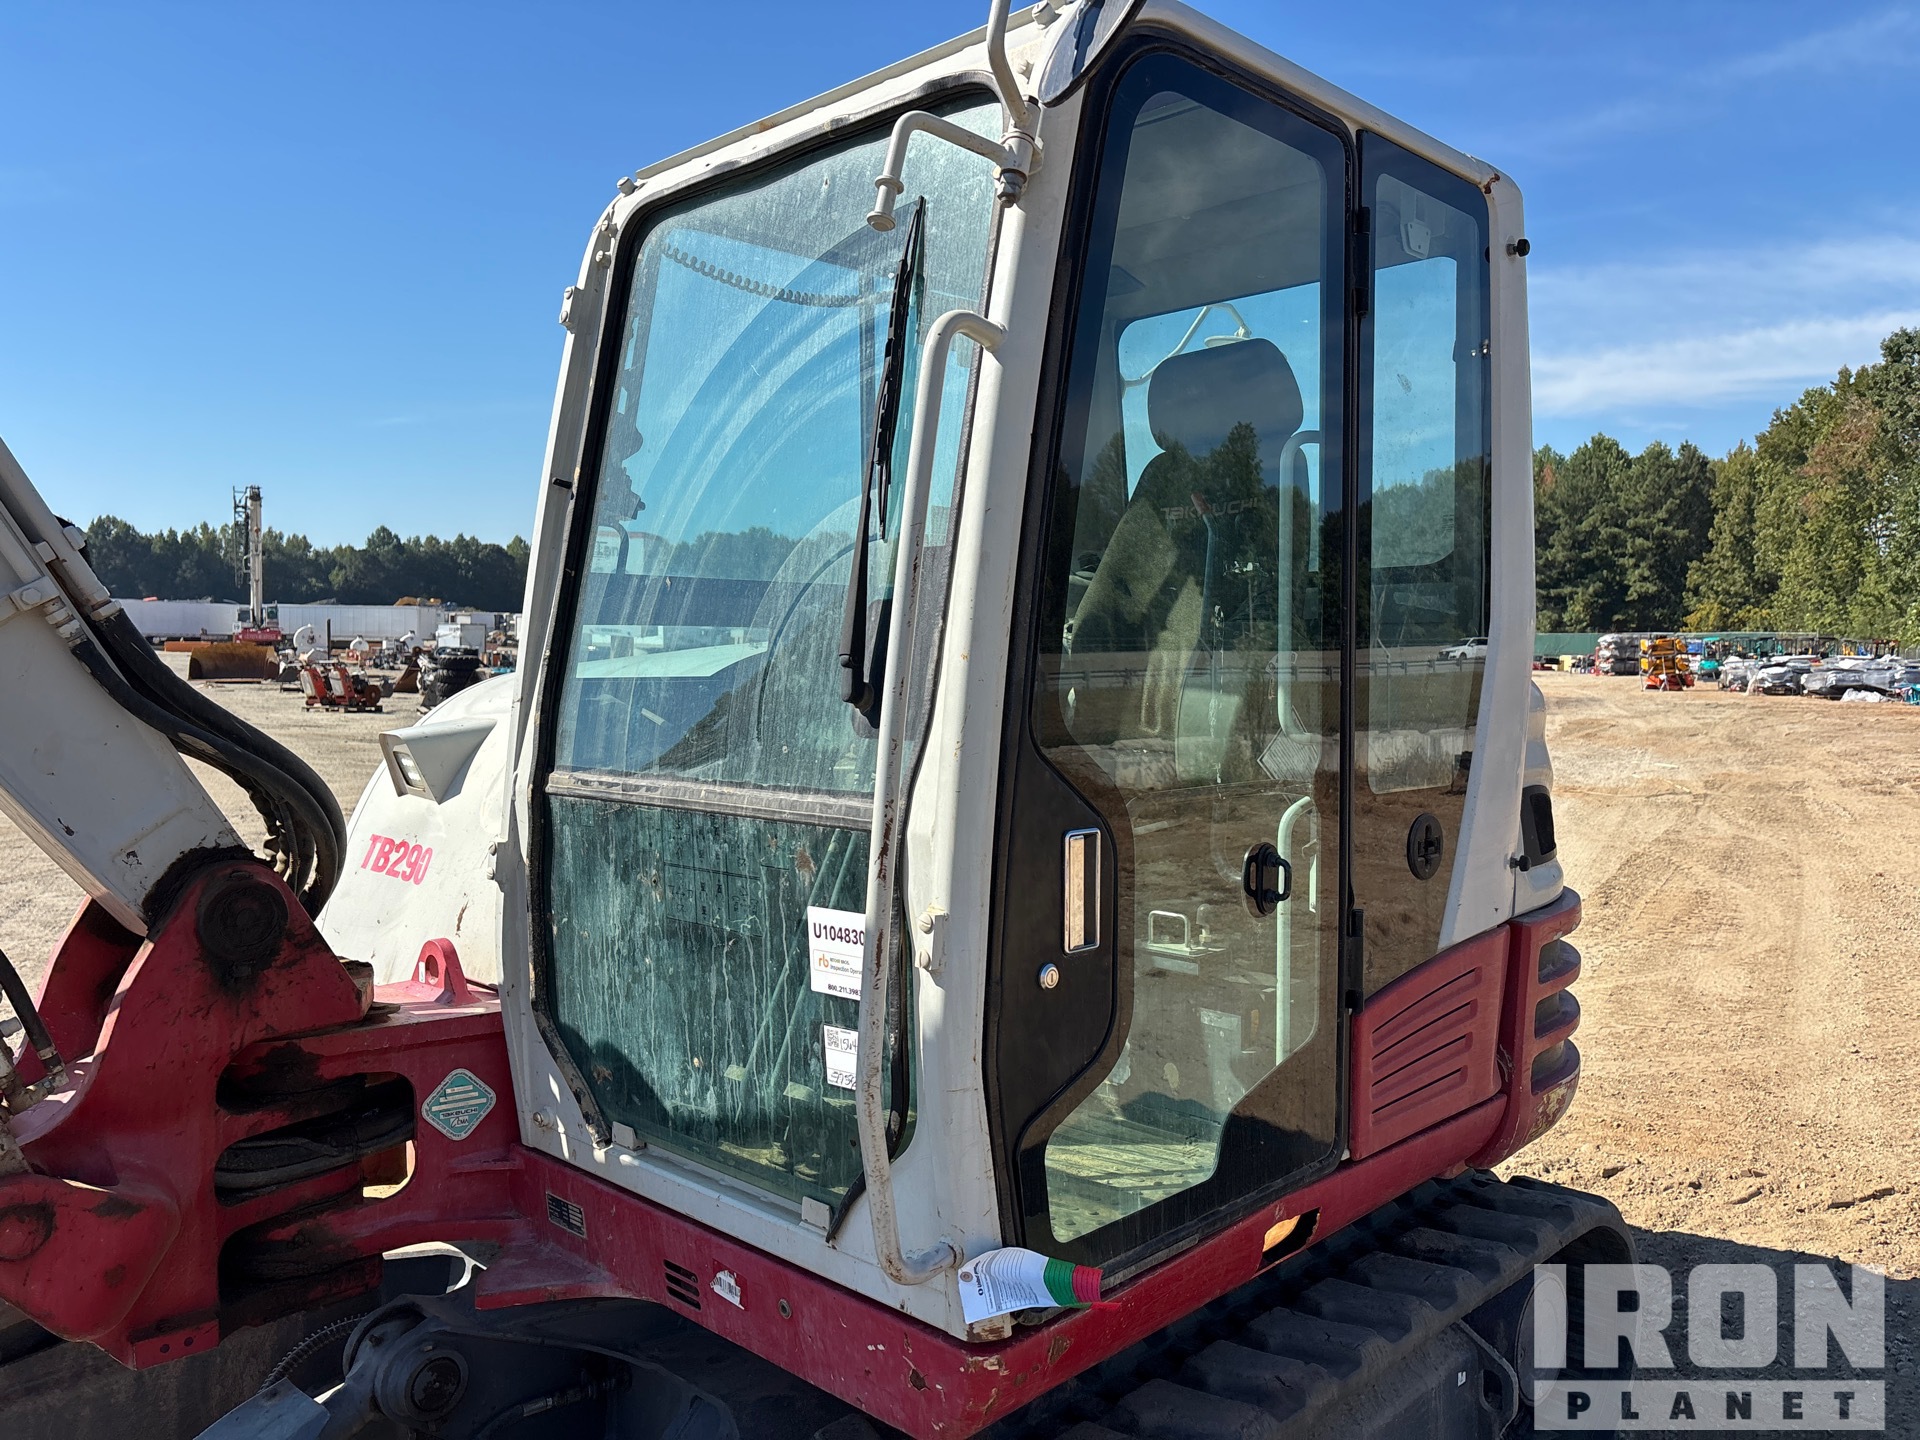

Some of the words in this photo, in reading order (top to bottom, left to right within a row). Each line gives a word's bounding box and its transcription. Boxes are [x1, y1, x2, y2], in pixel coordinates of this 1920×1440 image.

[1160, 497, 1257, 519] TAKUCHI
[361, 833, 433, 885] TB290
[818, 953, 829, 968] rb
[441, 1107, 478, 1118] TAKEUCHI
